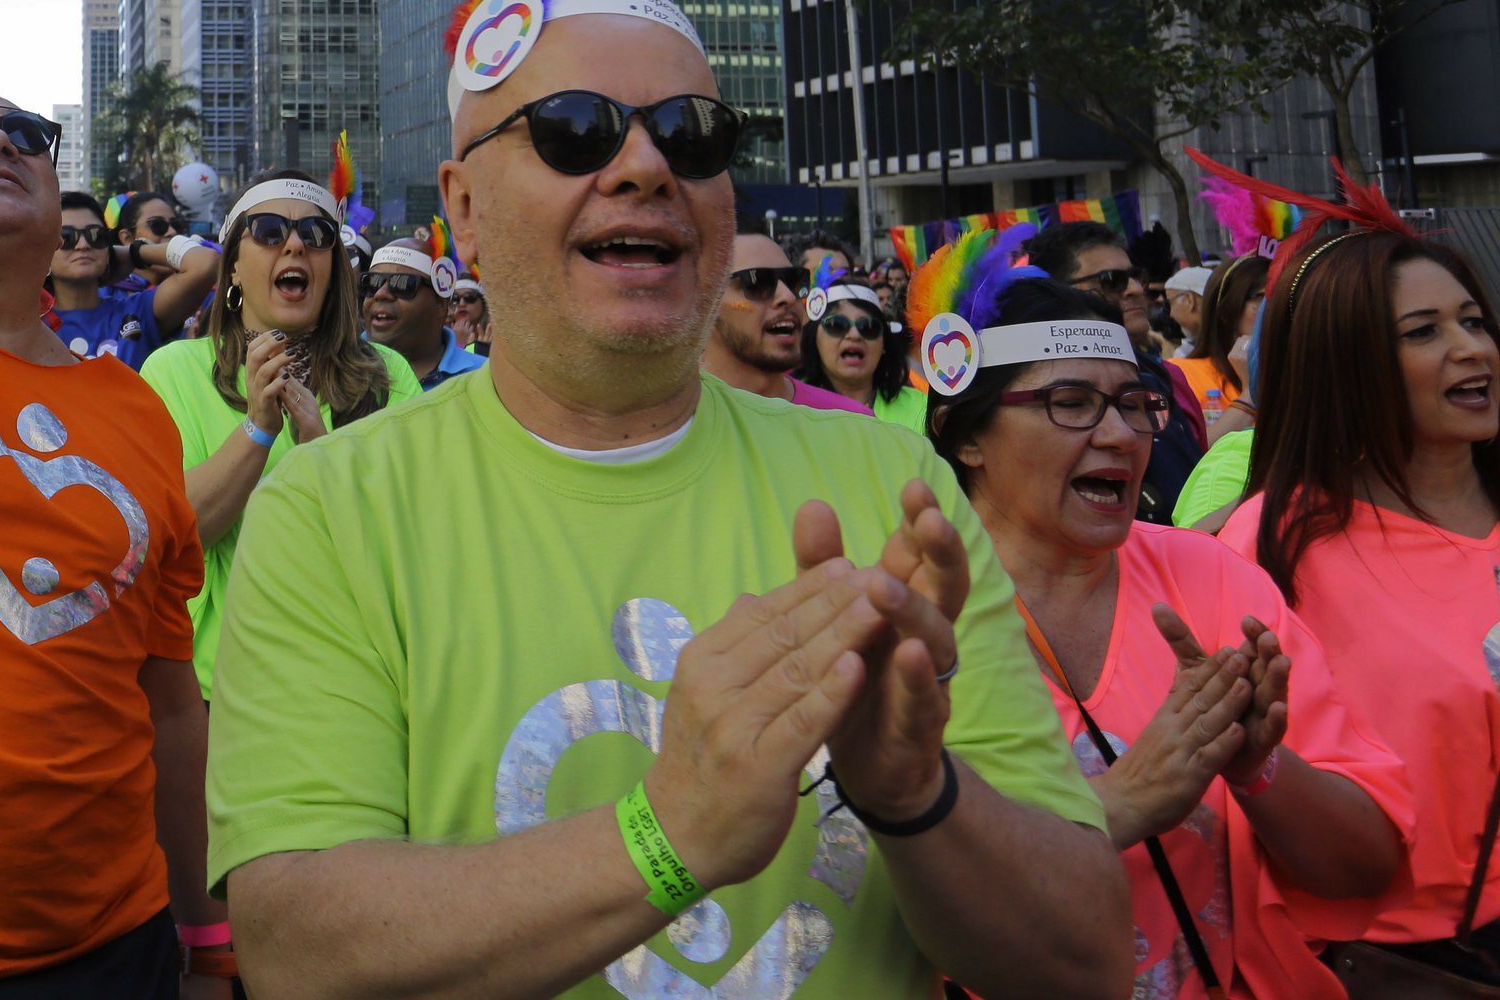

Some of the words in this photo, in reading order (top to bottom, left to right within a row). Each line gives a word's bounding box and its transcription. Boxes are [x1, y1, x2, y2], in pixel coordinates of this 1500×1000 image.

[644, 4, 673, 23] Paz
[306, 184, 324, 196] Amor
[1050, 325, 1112, 340] Esperança
[1055, 342, 1080, 354] Paz
[1092, 342, 1122, 355] Amor
[637, 806, 658, 837] LGBT
[634, 830, 665, 878] Parada
[654, 837, 696, 892] Orgulho
